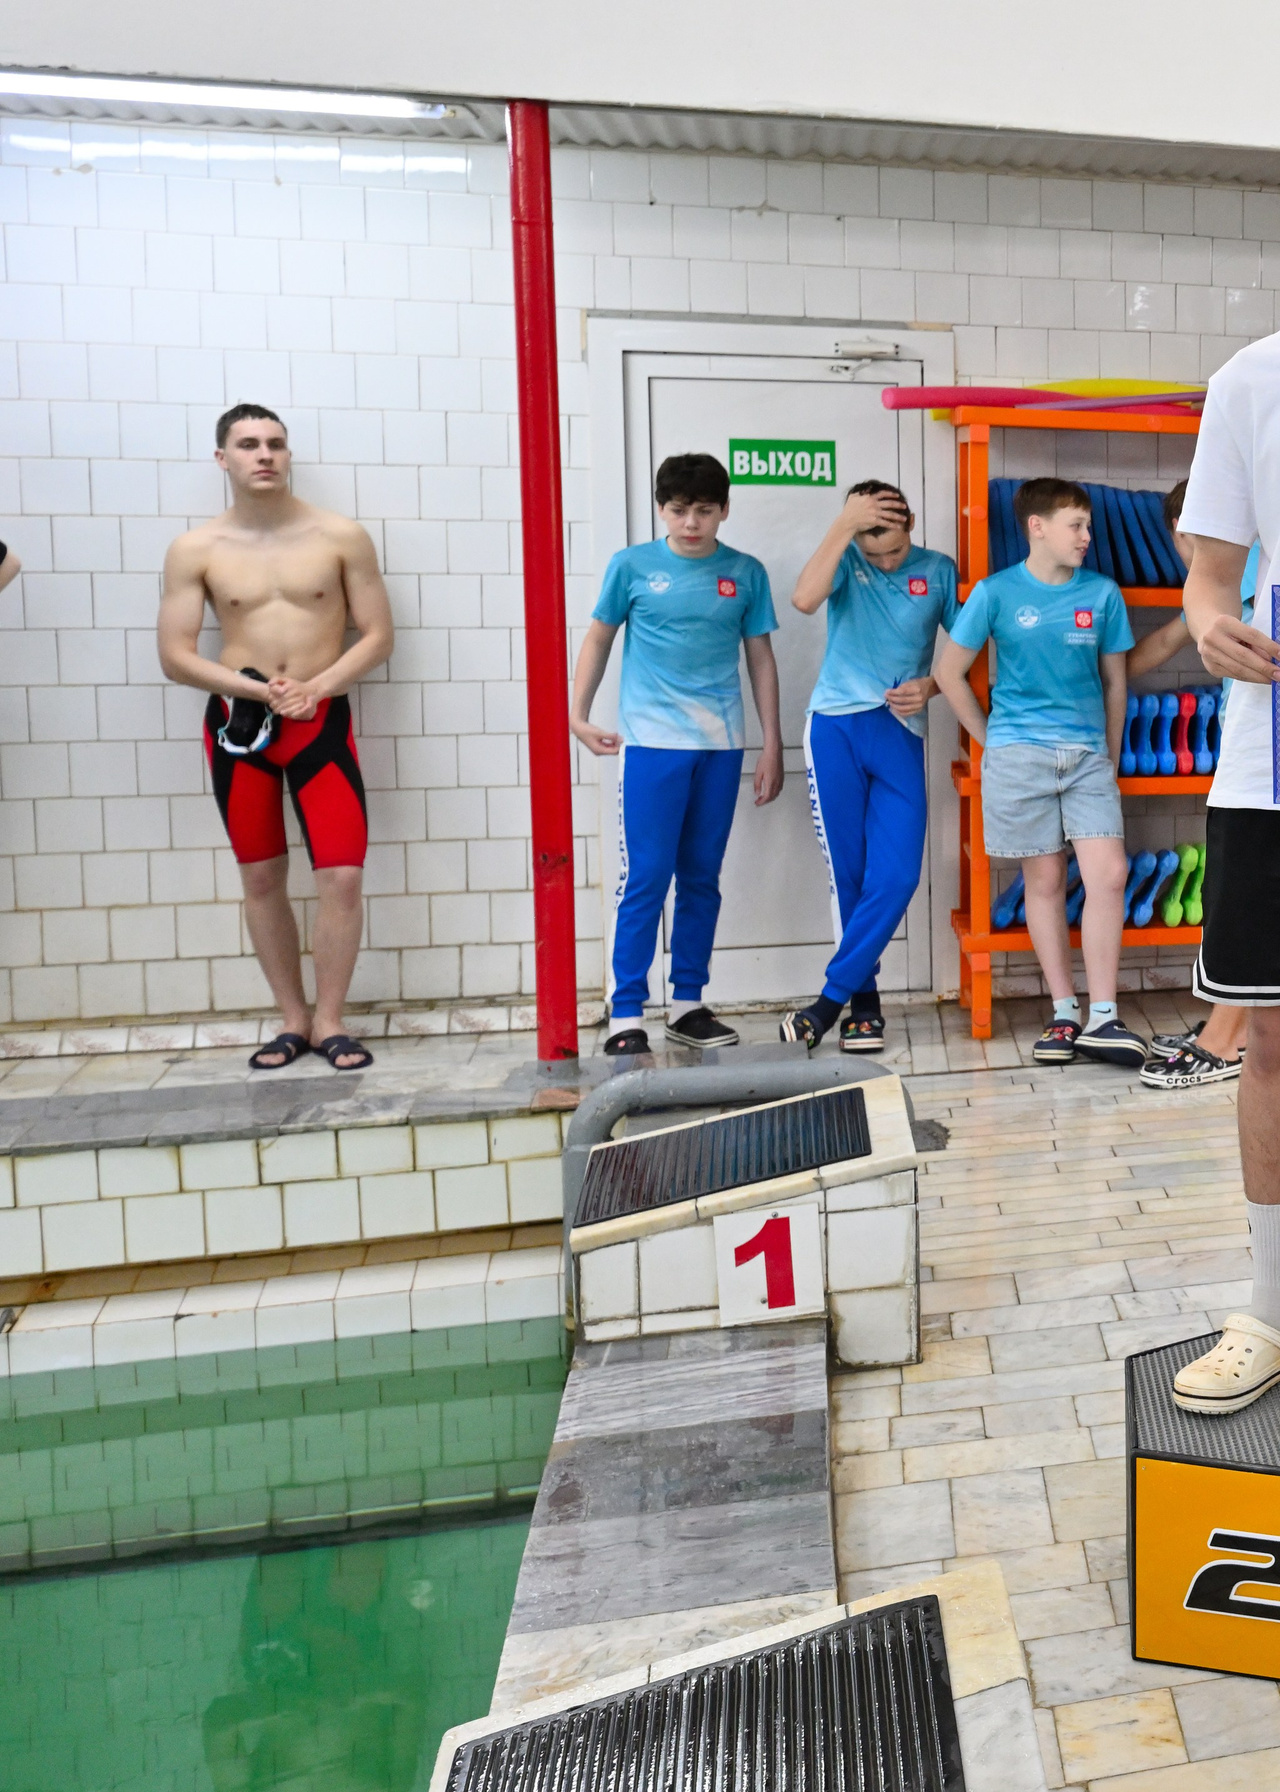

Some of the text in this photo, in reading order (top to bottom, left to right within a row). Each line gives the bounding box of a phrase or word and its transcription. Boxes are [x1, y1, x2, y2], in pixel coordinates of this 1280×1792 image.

[733, 450, 832, 482] ВЫХОД
[806, 766, 836, 895] SZHINSK
[1166, 1075, 1202, 1085] crocs
[734, 1216, 796, 1310] 1
